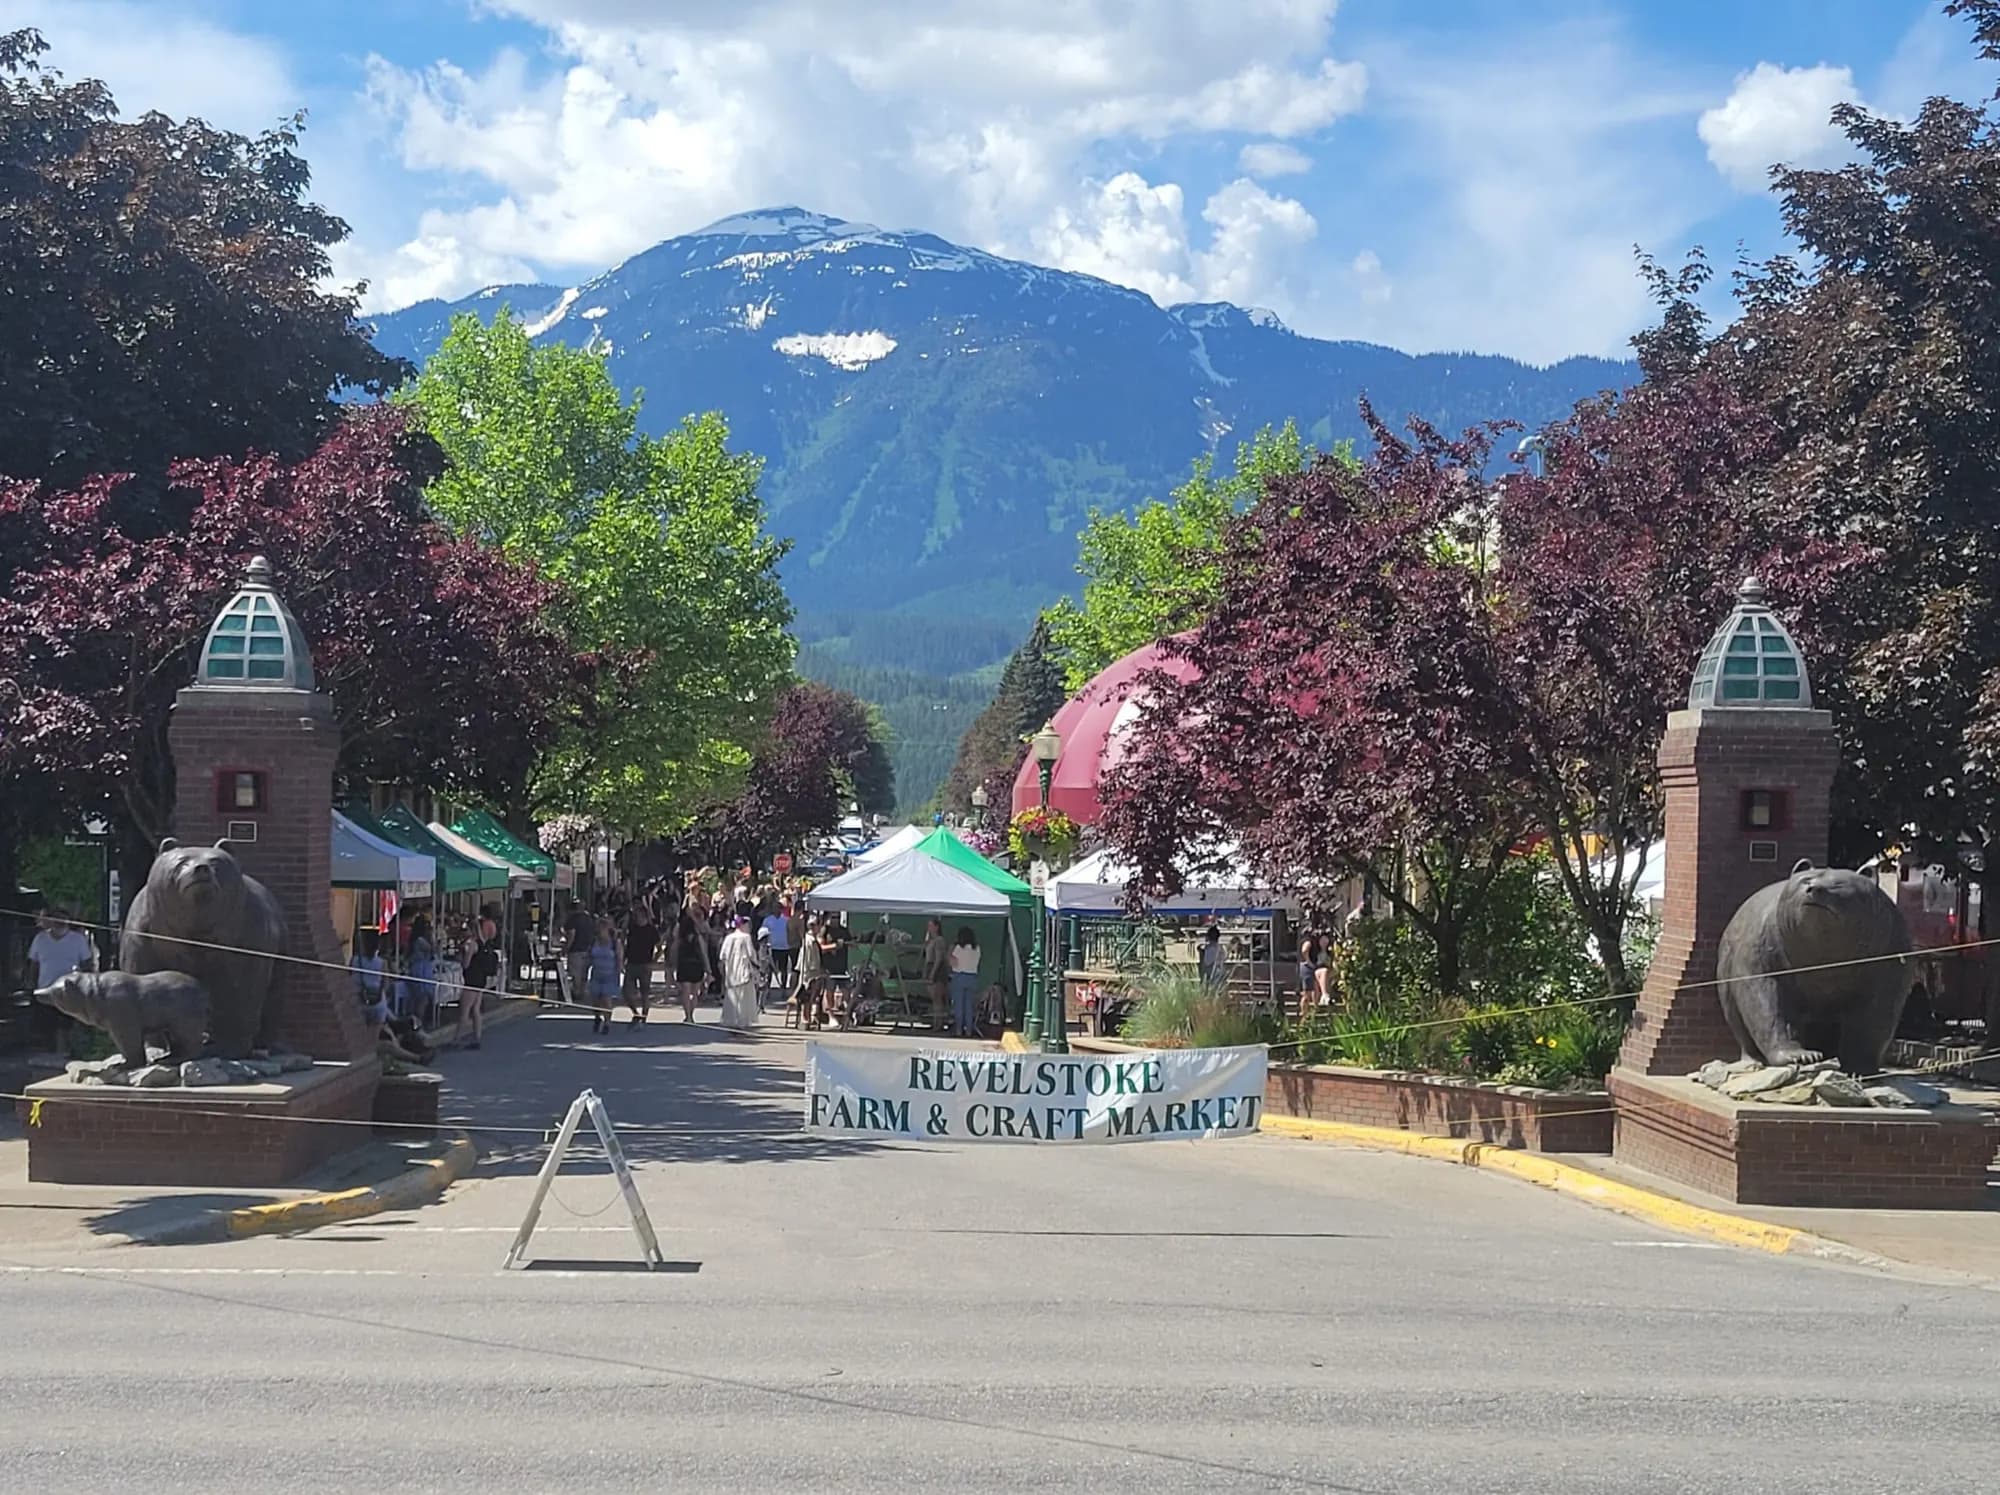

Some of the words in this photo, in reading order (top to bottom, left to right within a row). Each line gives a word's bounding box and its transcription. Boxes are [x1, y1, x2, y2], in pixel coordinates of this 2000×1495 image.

[909, 1056, 1165, 1096] REVELSTOKE
[810, 1093, 910, 1133] FARM
[926, 1104, 950, 1136] &
[965, 1103, 1090, 1141] CRAFT
[1106, 1095, 1262, 1138] MARKET
